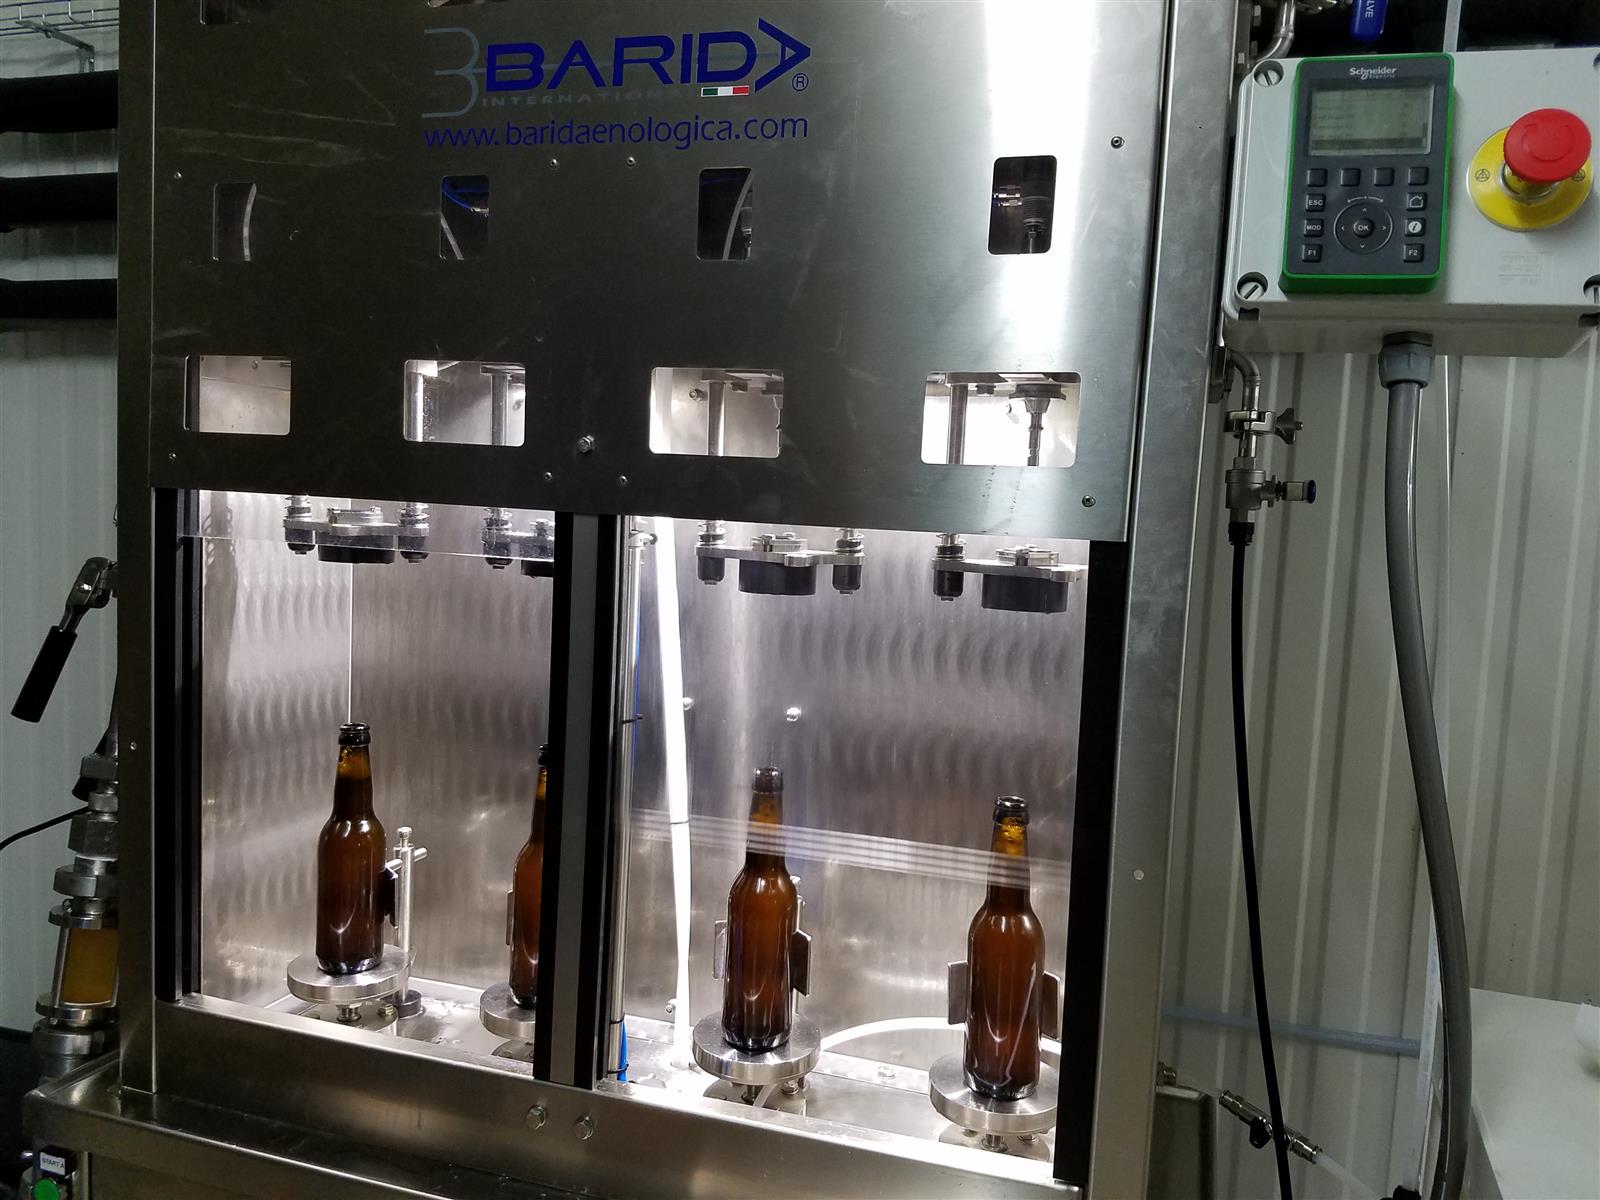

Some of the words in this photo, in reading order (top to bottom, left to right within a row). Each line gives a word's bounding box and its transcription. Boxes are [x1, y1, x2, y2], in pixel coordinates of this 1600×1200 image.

[1364, 0, 1375, 18] LVE
[485, 17, 811, 93] BARIDA
[1350, 66, 1397, 80] Schneider
[422, 115, 809, 151] www.baridaenologica.com
[42, 1157, 60, 1167] START
